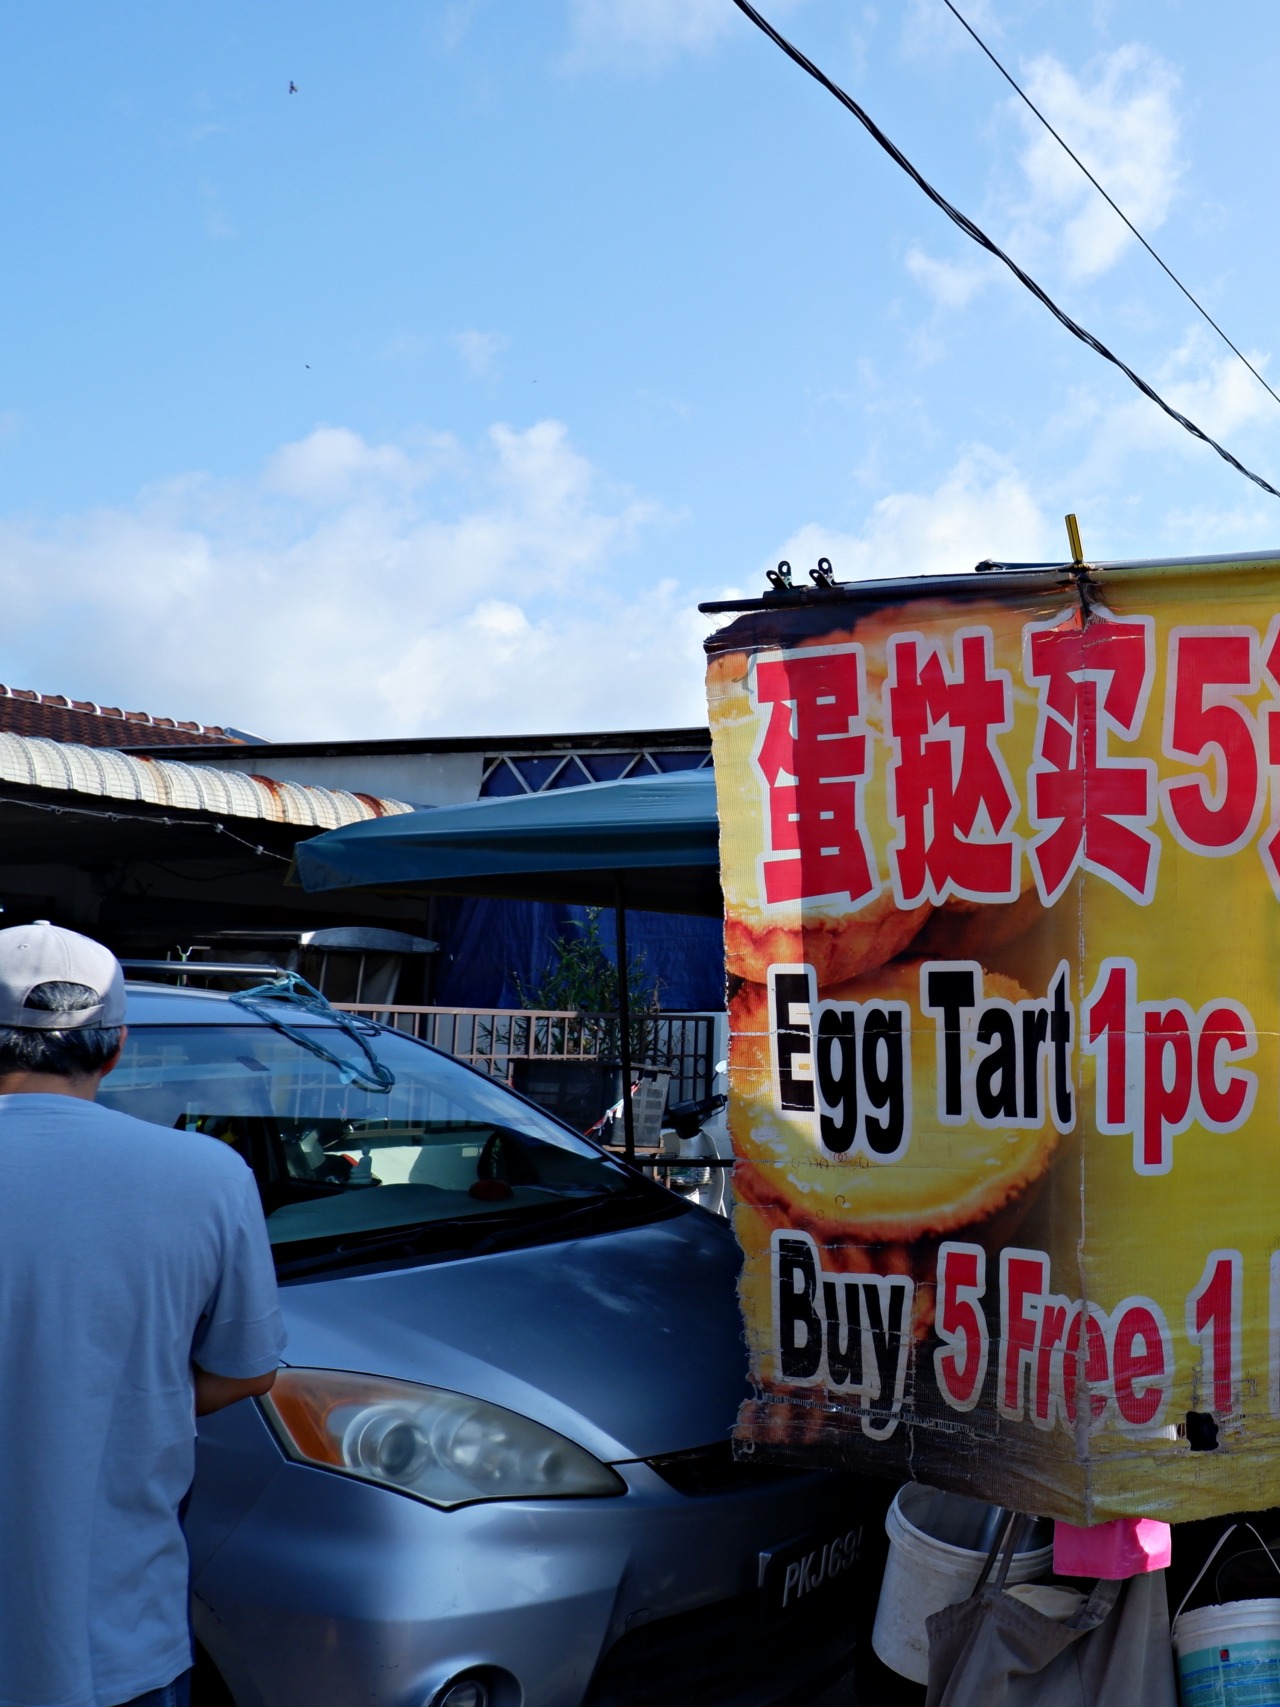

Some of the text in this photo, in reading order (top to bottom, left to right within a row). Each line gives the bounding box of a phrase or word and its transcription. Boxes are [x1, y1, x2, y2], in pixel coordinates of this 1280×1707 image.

[775, 973, 904, 1154] Egg
[928, 970, 1072, 1124] Tart
[1089, 967, 1248, 1165] 1pc
[778, 1238, 905, 1430] Buy
[939, 1252, 980, 1400] 5
[1004, 1258, 1166, 1425] Free
[1195, 1259, 1233, 1413] 1
